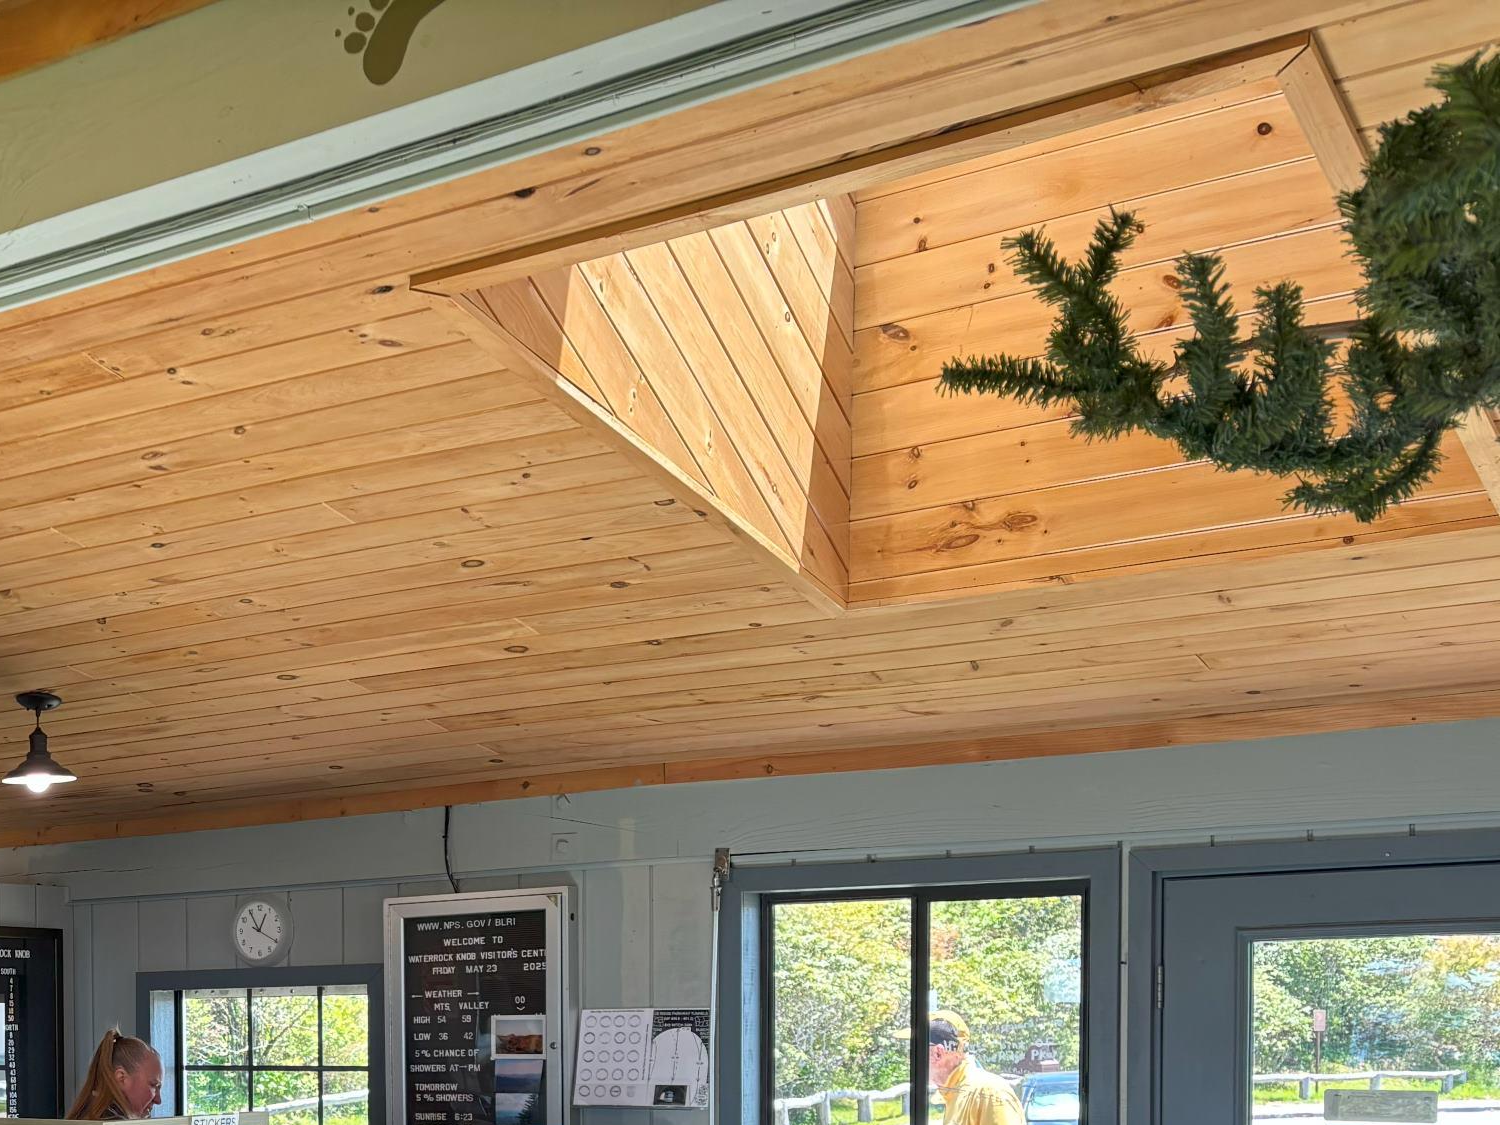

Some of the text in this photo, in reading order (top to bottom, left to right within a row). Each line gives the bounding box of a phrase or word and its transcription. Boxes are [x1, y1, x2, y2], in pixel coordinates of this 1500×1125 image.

[444, 936, 503, 946] WELCOME TO
[15, 950, 30, 958] KNOB
[408, 953, 453, 963] WATERROCK
[456, 952, 476, 961] KNOB
[522, 949, 546, 958] CENT
[432, 967, 455, 975] FRIDAY
[466, 965, 484, 974] MAY
[486, 964, 498, 972] 23
[425, 990, 462, 998] WEATHER
[459, 1002, 489, 1010] VALLEY
